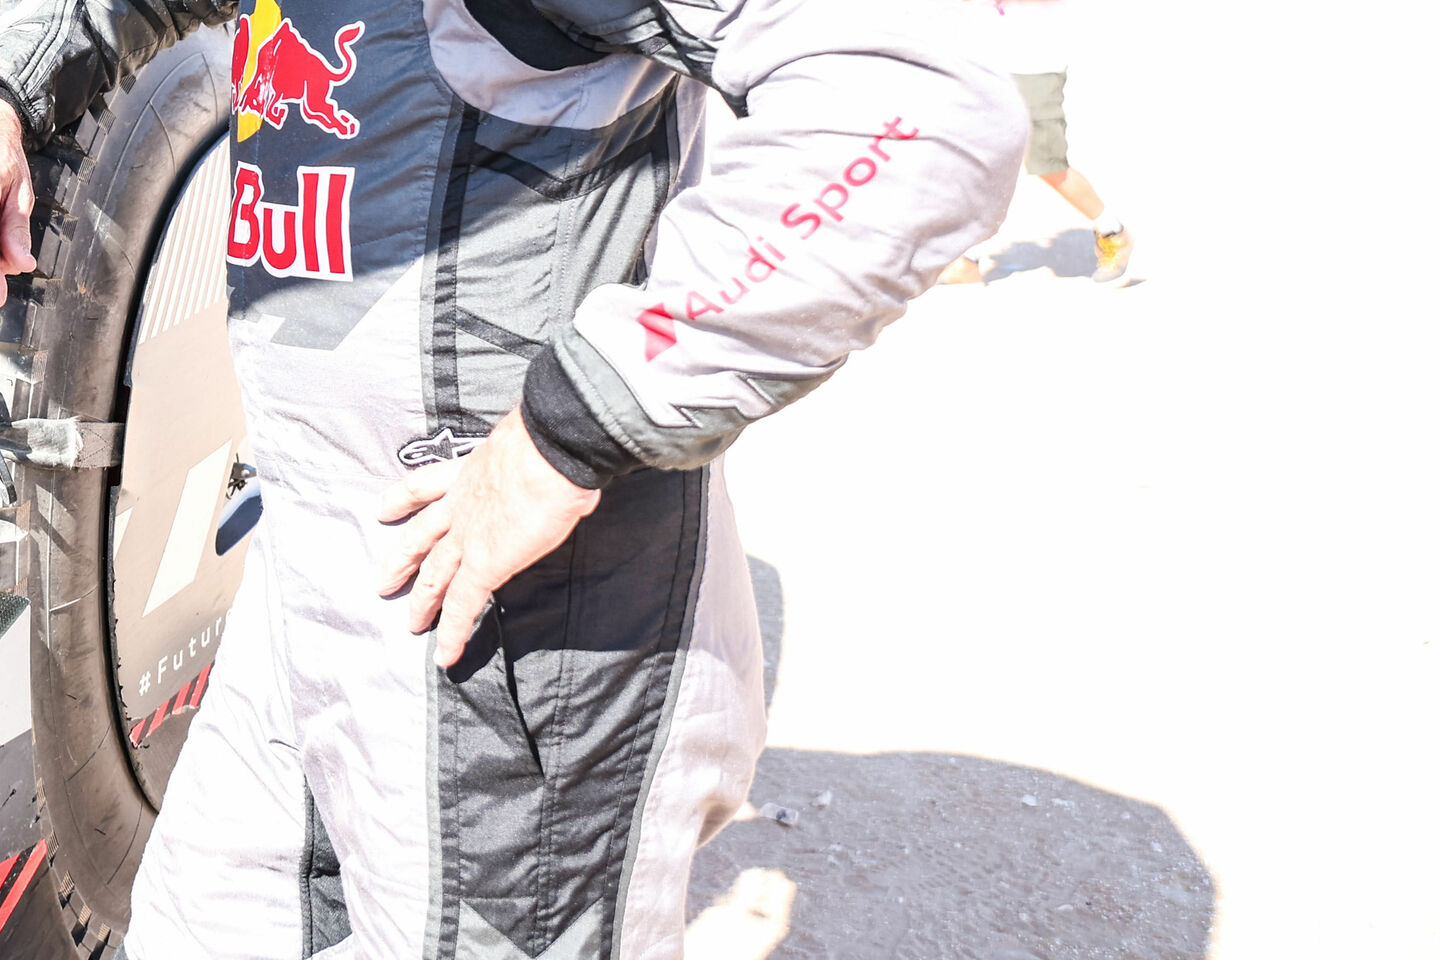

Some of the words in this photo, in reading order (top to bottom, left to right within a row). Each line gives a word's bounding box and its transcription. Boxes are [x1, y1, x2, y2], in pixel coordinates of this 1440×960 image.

[226, 161, 355, 282] Bull
[685, 236, 787, 321] Audi
[779, 116, 920, 241] Sport
[138, 616, 223, 697] #Futur
